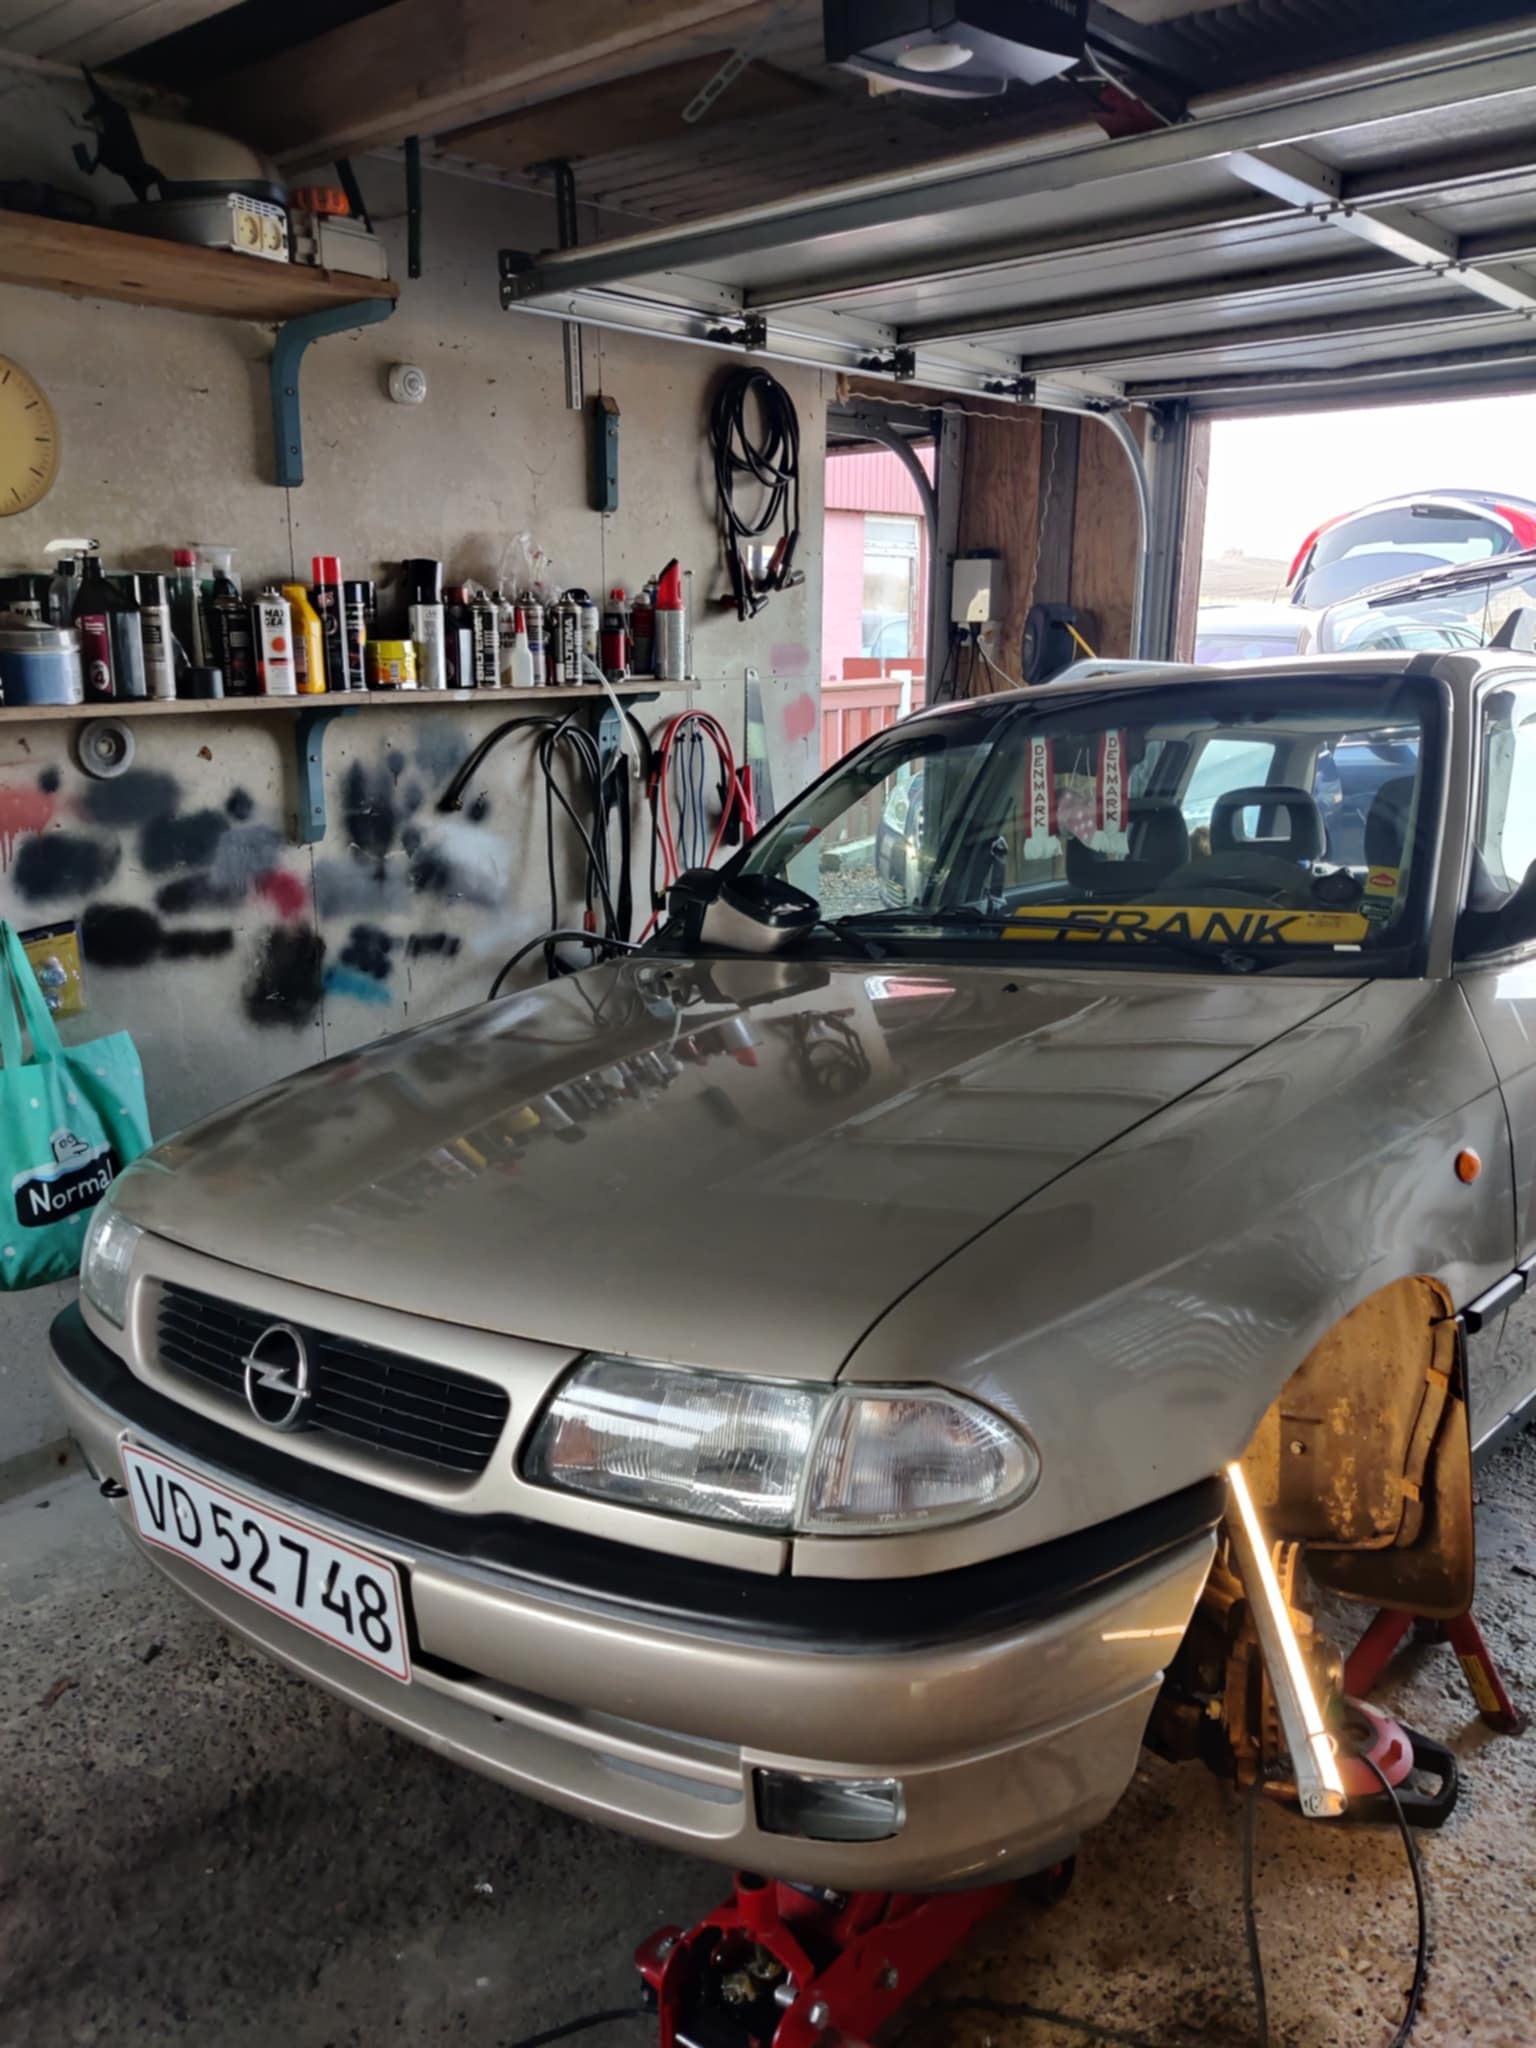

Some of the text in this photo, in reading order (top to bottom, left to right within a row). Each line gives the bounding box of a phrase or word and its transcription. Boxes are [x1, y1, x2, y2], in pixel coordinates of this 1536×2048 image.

[564, 617, 574, 679] BILTEMA
[1033, 744, 1046, 827] DENMARK
[1106, 737, 1118, 822] DENMARK
[1055, 909, 1300, 943] FRANK
[29, 1158, 113, 1216] Normal
